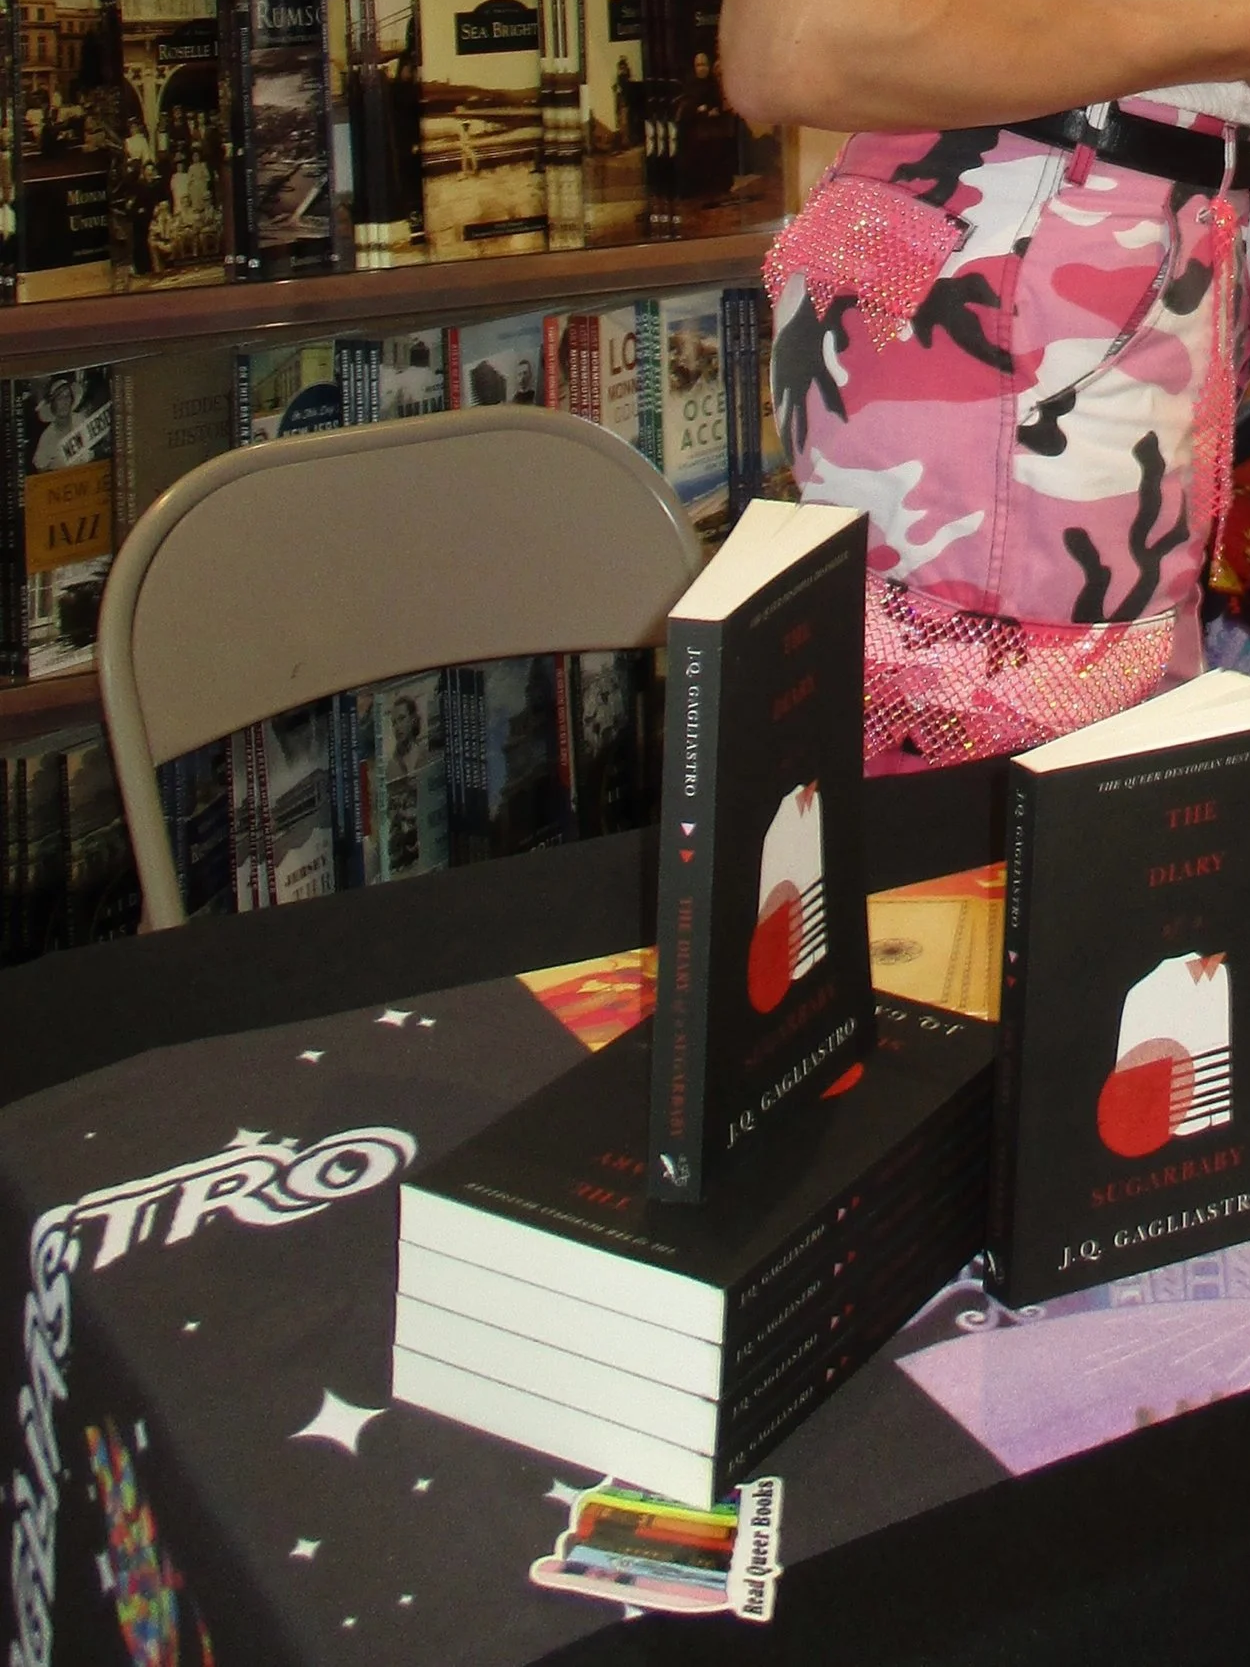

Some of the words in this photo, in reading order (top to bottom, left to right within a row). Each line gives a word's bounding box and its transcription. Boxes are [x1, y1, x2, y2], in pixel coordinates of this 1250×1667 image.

[461, 22, 489, 41] SEA
[158, 41, 211, 63] ROSELLE
[69, 213, 108, 233] UNIVE
[47, 483, 87, 506] NEW
[48, 512, 100, 551] JAZZ
[686, 646, 703, 678] J.Q.
[683, 685, 703, 798] GAGLIASTRO
[1098, 779, 1121, 793] THE
[1124, 770, 1162, 790] QUEER
[1163, 758, 1223, 781] DYSTOPIAN
[1165, 800, 1218, 830] THE
[1009, 824, 1027, 930] GAGLIASTRO
[1147, 850, 1227, 888] DIARY
[727, 1108, 757, 1150] J.Q.
[760, 1016, 857, 1112] GAGLIASTRO
[1090, 1145, 1247, 1208] SUGARBABY
[1058, 1239, 1103, 1271] J.Q.
[750, 1479, 775, 1527] Books
[745, 1530, 774, 1576] Queer
[742, 1579, 766, 1616] Read
